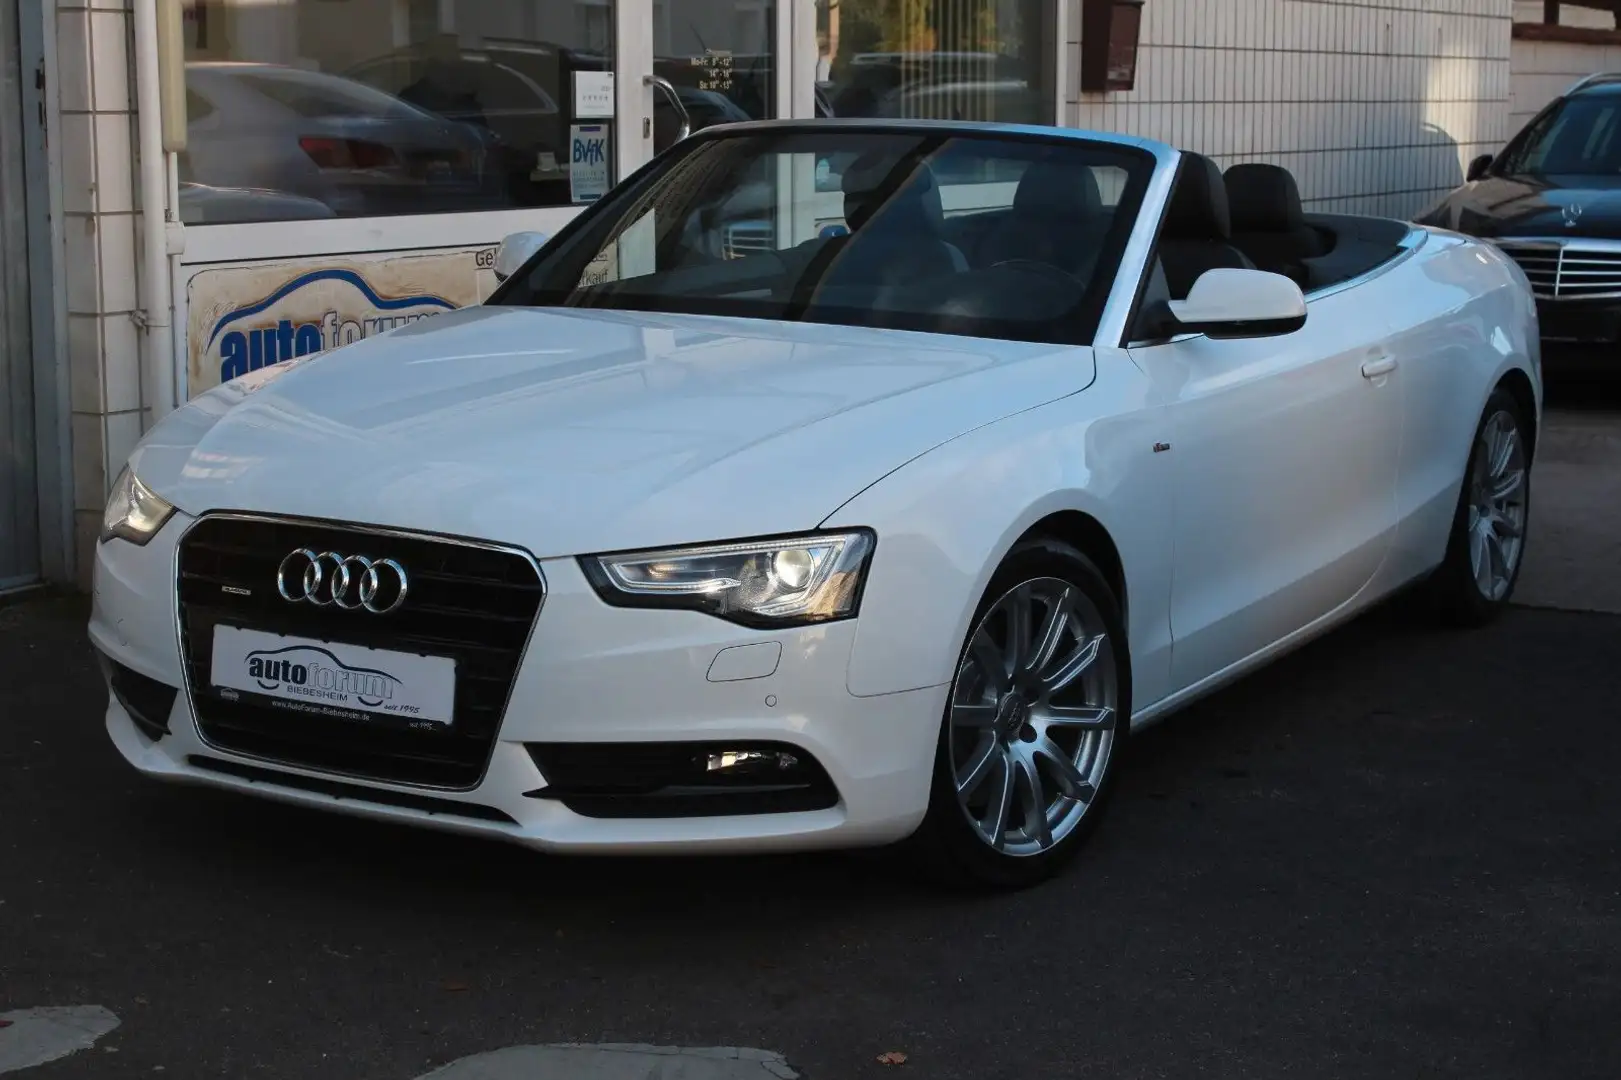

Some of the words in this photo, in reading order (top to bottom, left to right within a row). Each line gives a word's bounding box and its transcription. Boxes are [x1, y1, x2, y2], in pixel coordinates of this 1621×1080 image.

[475, 247, 496, 267] Ge
[220, 311, 441, 383] autof
[249, 657, 394, 699] autoforum
[287, 685, 348, 702] BIEBESHEIM
[384, 704, 398, 712] seit
[400, 704, 421, 714] 1995
